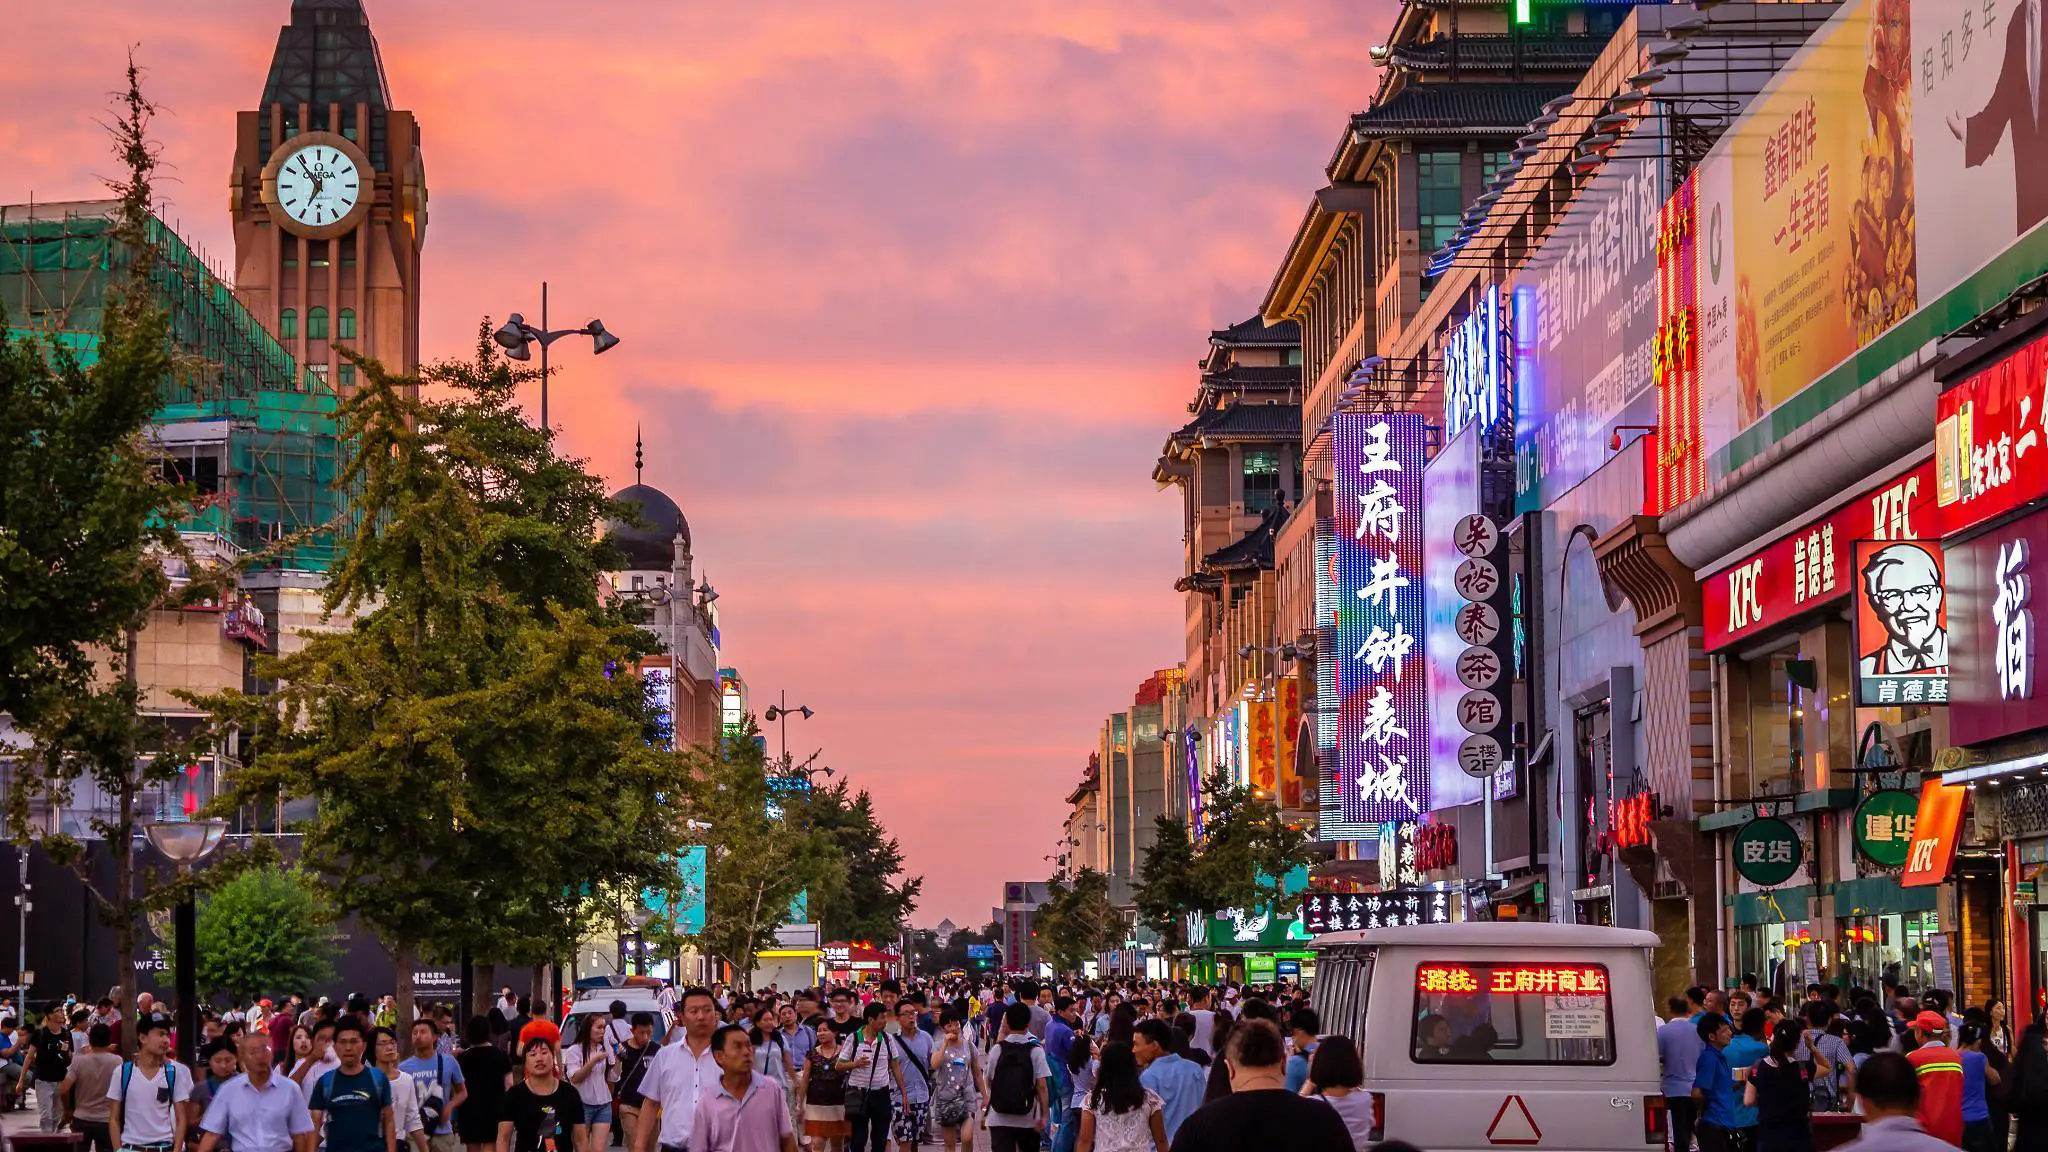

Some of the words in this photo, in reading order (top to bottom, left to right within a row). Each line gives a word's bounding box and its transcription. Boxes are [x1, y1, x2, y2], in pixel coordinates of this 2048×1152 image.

[1921, 0, 1996, 97] 相知多年
[1763, 95, 1817, 202] 鑫福相伴
[1773, 162, 1830, 255] 一生幸福
[1536, 157, 1657, 368] 声望听力服务机构
[1607, 298, 1632, 338] Hearing
[1872, 475, 1920, 540] KFC
[1728, 558, 1763, 632] KFC
[1794, 523, 1836, 604] 肯德基
[1355, 420, 1418, 813] 王府井钟表城
[1459, 515, 1497, 724] 吴裕泰茶馆
[1993, 538, 2027, 699] 稻
[1878, 679, 1948, 703] 肯德基
[1463, 745, 1496, 758] 二楼
[1470, 759, 1495, 772] 2F
[1743, 840, 1792, 863] 皮货
[1866, 814, 1917, 842] 建华
[1909, 838, 1939, 873] KFC
[1308, 895, 1420, 912] 名表全场八折
[1491, 968, 1605, 993] 王府井商业
